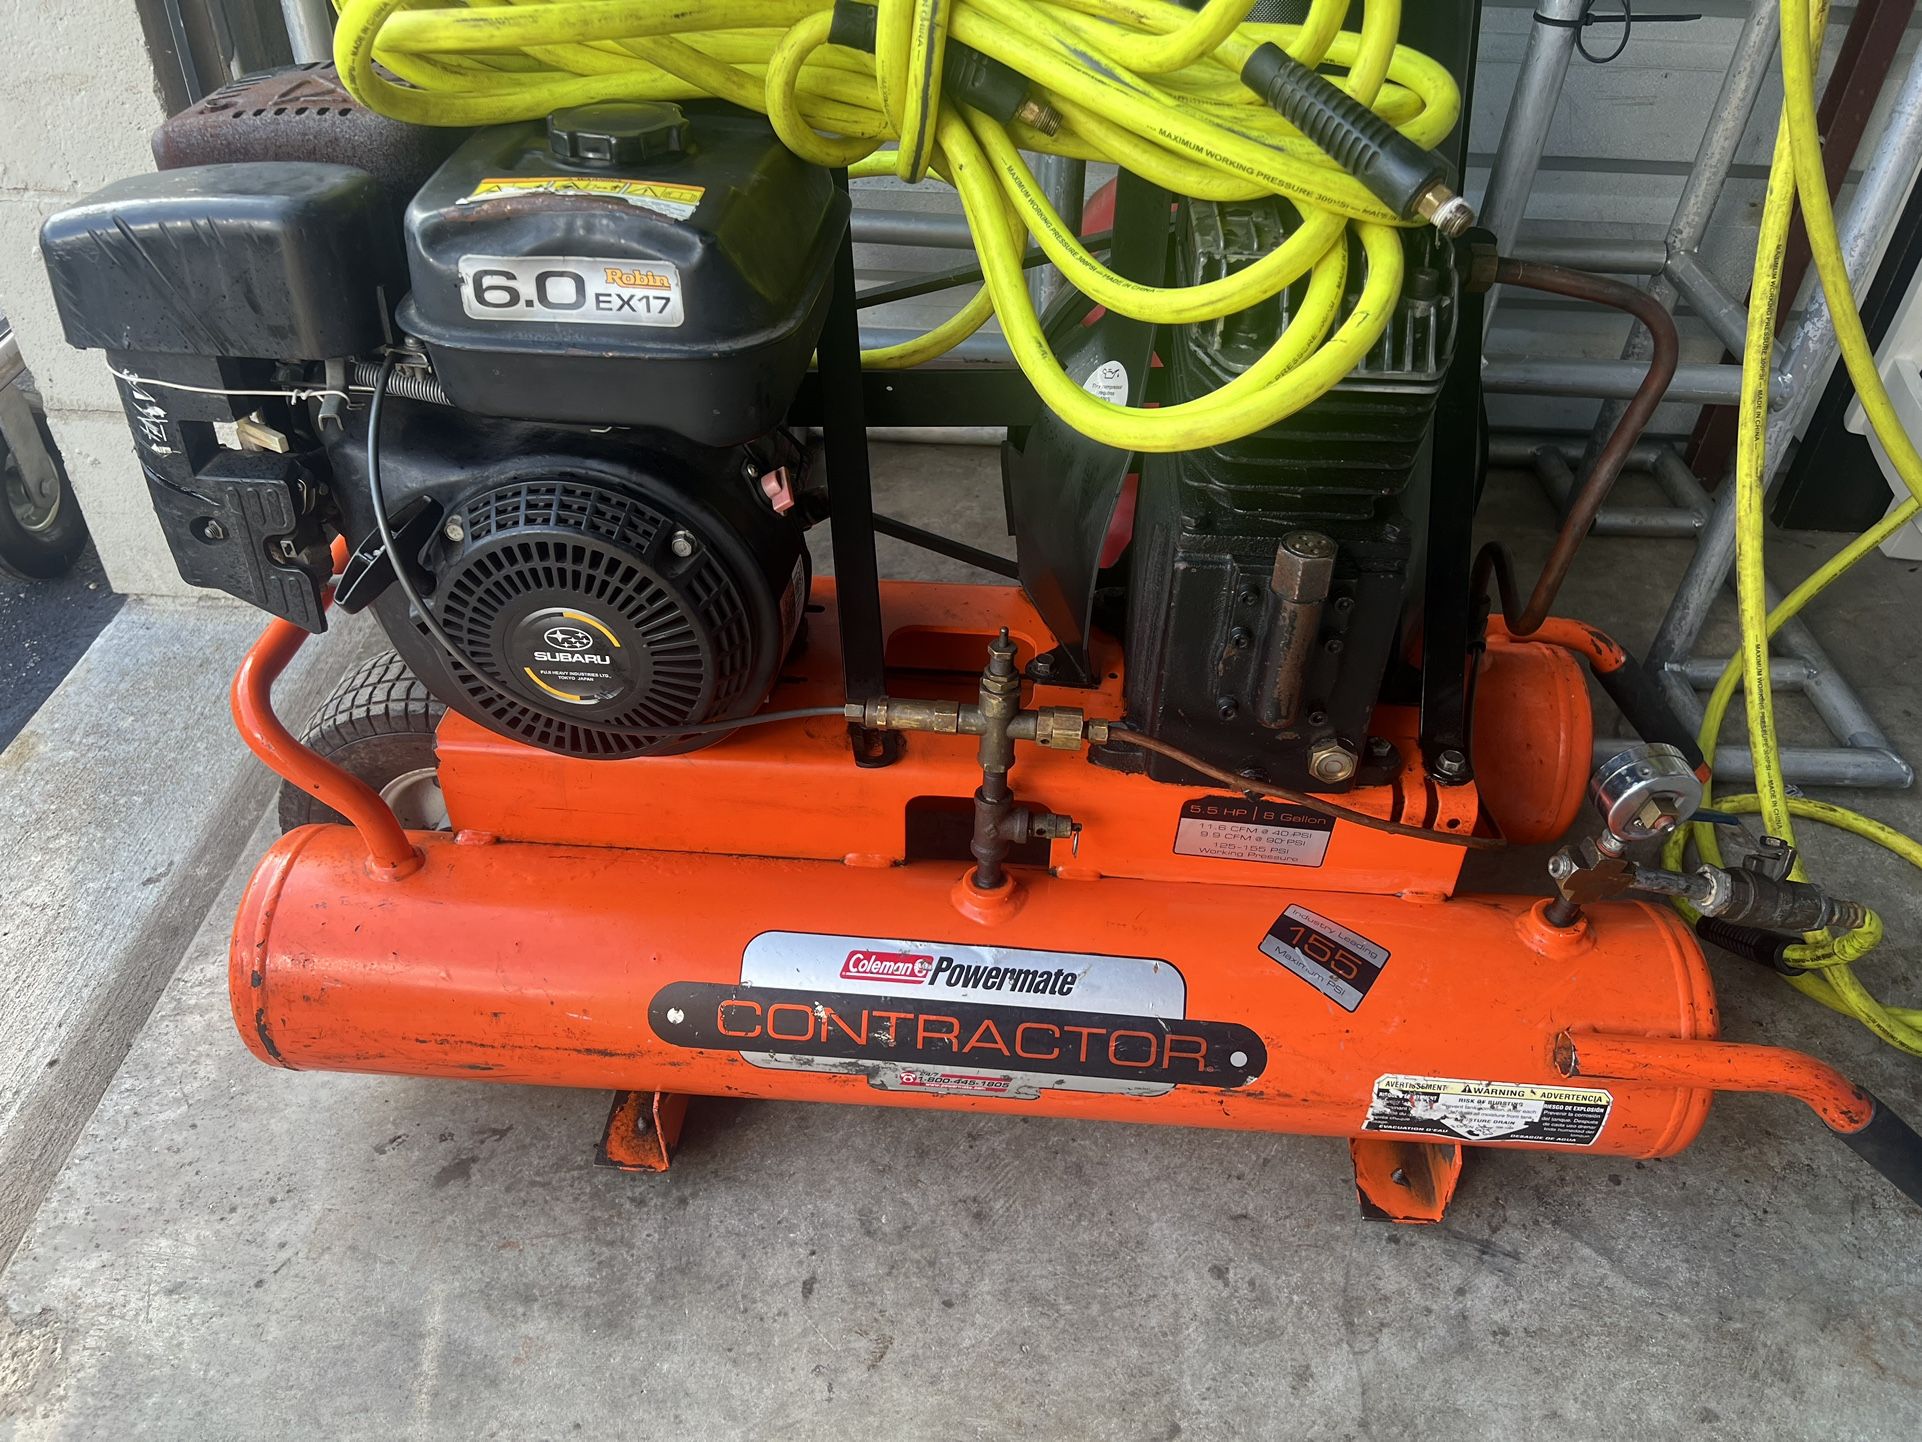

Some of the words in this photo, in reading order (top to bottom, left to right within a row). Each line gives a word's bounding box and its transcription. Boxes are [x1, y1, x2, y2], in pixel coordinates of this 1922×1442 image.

[1158, 127, 1205, 154] MAXIMUM
[1204, 148, 1255, 176] WORKING
[1256, 170, 1314, 199] PRESSURE
[1006, 165, 1031, 199] MAXIMUM
[1028, 198, 1051, 229] WORKING
[1050, 226, 1078, 260] PRESSURE
[1077, 255, 1097, 272] 300PSI
[1103, 273, 1122, 286] MADE
[472, 269, 587, 311] 6.0
[604, 268, 672, 291] Robin
[594, 293, 671, 314] EX17
[1768, 281, 1778, 316] WORKING
[1761, 316, 1773, 355] PRESSURE
[1754, 418, 1762, 441] CHINA
[533, 651, 611, 665] SUBARU
[1757, 677, 1766, 710] WORKING
[1767, 779, 1776, 801] MADE
[1773, 810, 1783, 830] CHINA
[1190, 804, 1219, 815] 5.5
[1223, 808, 1248, 817] HP
[1263, 811, 1275, 820] 8
[1280, 813, 1327, 825] Gallon
[1200, 822, 1227, 831] 11.6
[1230, 825, 1258, 834] CFM
[1271, 829, 1290, 837] 40
[1200, 830, 1221, 838] 9.9
[1224, 833, 1252, 841] CFM
[1265, 837, 1283, 845] 90
[1199, 847, 1244, 857] Working
[1247, 852, 1299, 862] Pressure
[1214, 841, 1267, 853] 125-155
[1270, 846, 1289, 854] PSI
[1292, 909, 1337, 934] Industry
[1337, 931, 1378, 960] Leading
[1289, 926, 1363, 980] 155
[848, 953, 914, 976] Coleman
[928, 956, 1078, 997] Powermate
[1274, 946, 1324, 982] Maximum
[1326, 980, 1346, 996] PSI
[717, 1000, 1209, 1071] CONTRACTOR
[918, 1076, 1010, 1088] 1-800-445-1805
[1473, 1087, 1525, 1097] WARNING
[1540, 1091, 1603, 1103] ADVERTENCIA
